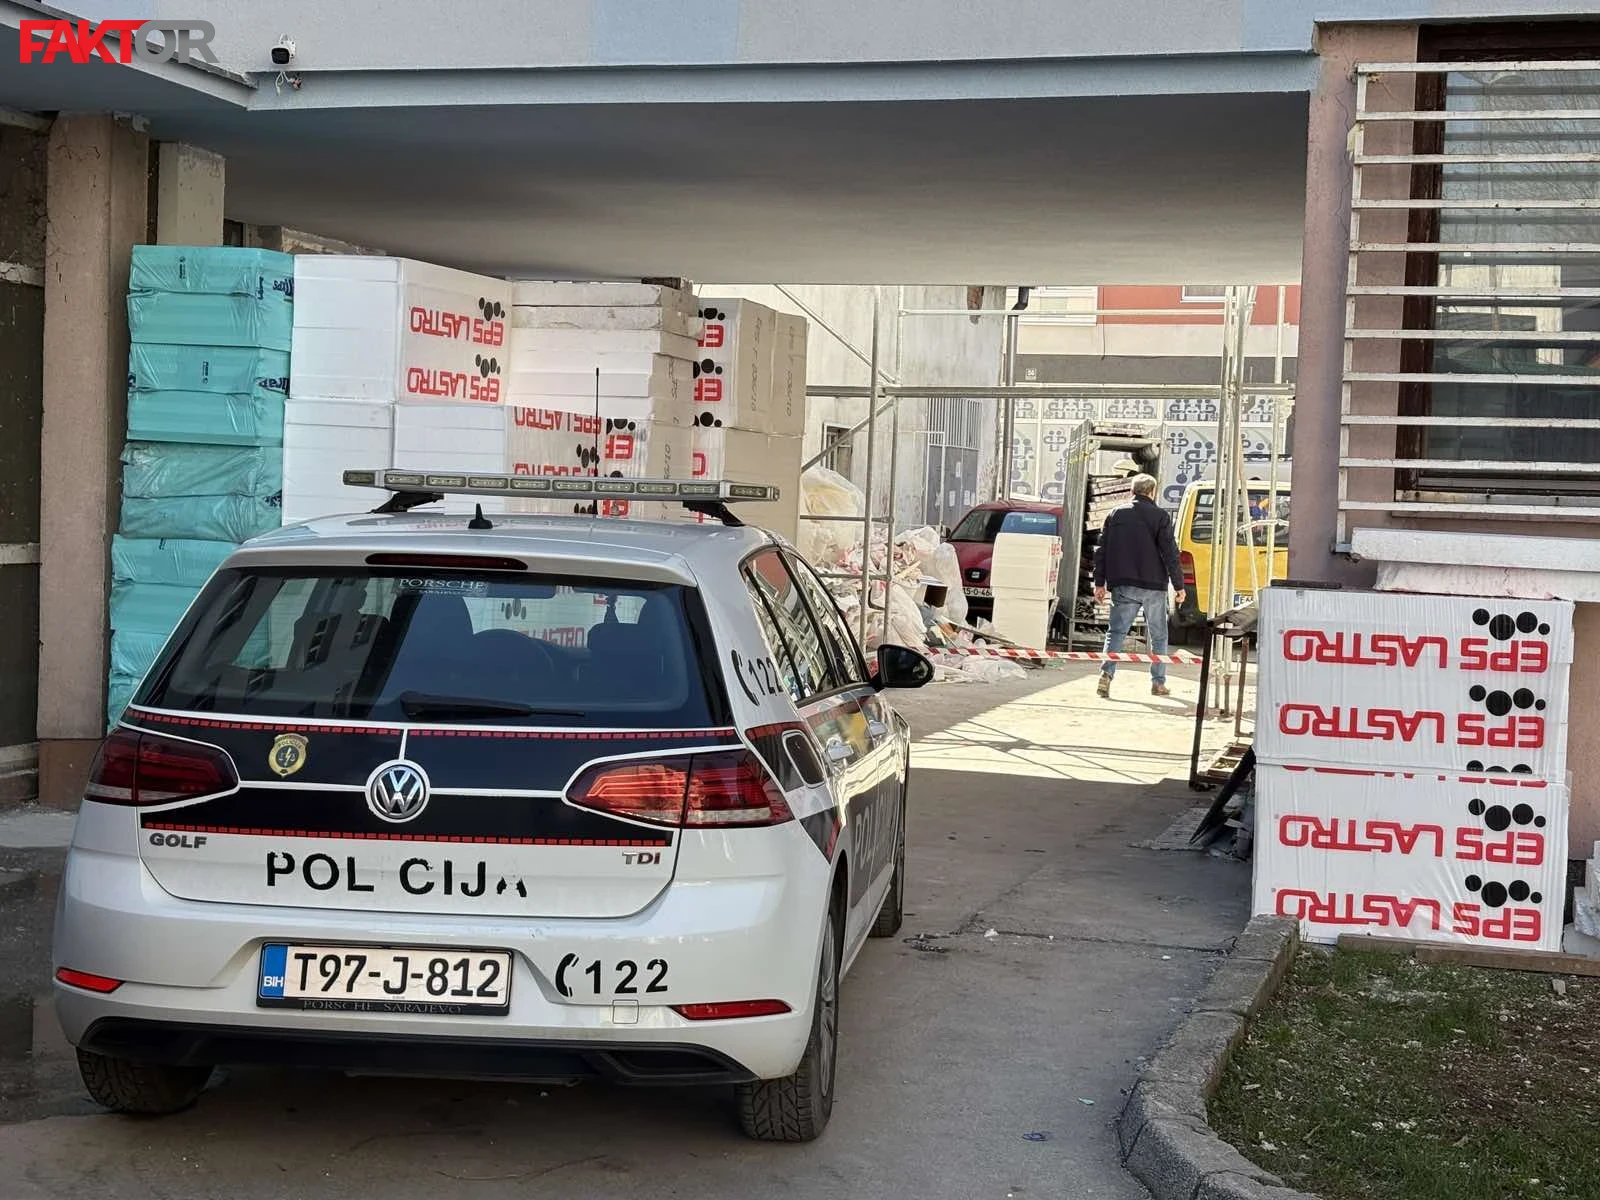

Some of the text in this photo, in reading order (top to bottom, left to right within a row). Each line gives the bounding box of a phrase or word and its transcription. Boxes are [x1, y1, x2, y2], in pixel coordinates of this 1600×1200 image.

[409, 306, 504, 347] EPS LASTRO
[407, 367, 501, 403] EPS LASTRO
[399, 578, 489, 590] PORSCHE
[1282, 629, 1549, 673] EPS LASTRO
[1279, 703, 1545, 749] EPS LASTRO
[149, 832, 208, 849] GOLF
[621, 851, 661, 865] TDI
[1279, 814, 1545, 866] EPS LASTRO
[1275, 888, 1541, 943] EPS LASTRO
[263, 975, 284, 988] BIH
[294, 953, 499, 998] T97-J-812
[585, 958, 670, 995] 122
[303, 1000, 462, 1014] PORSCHE SARAJEVO
